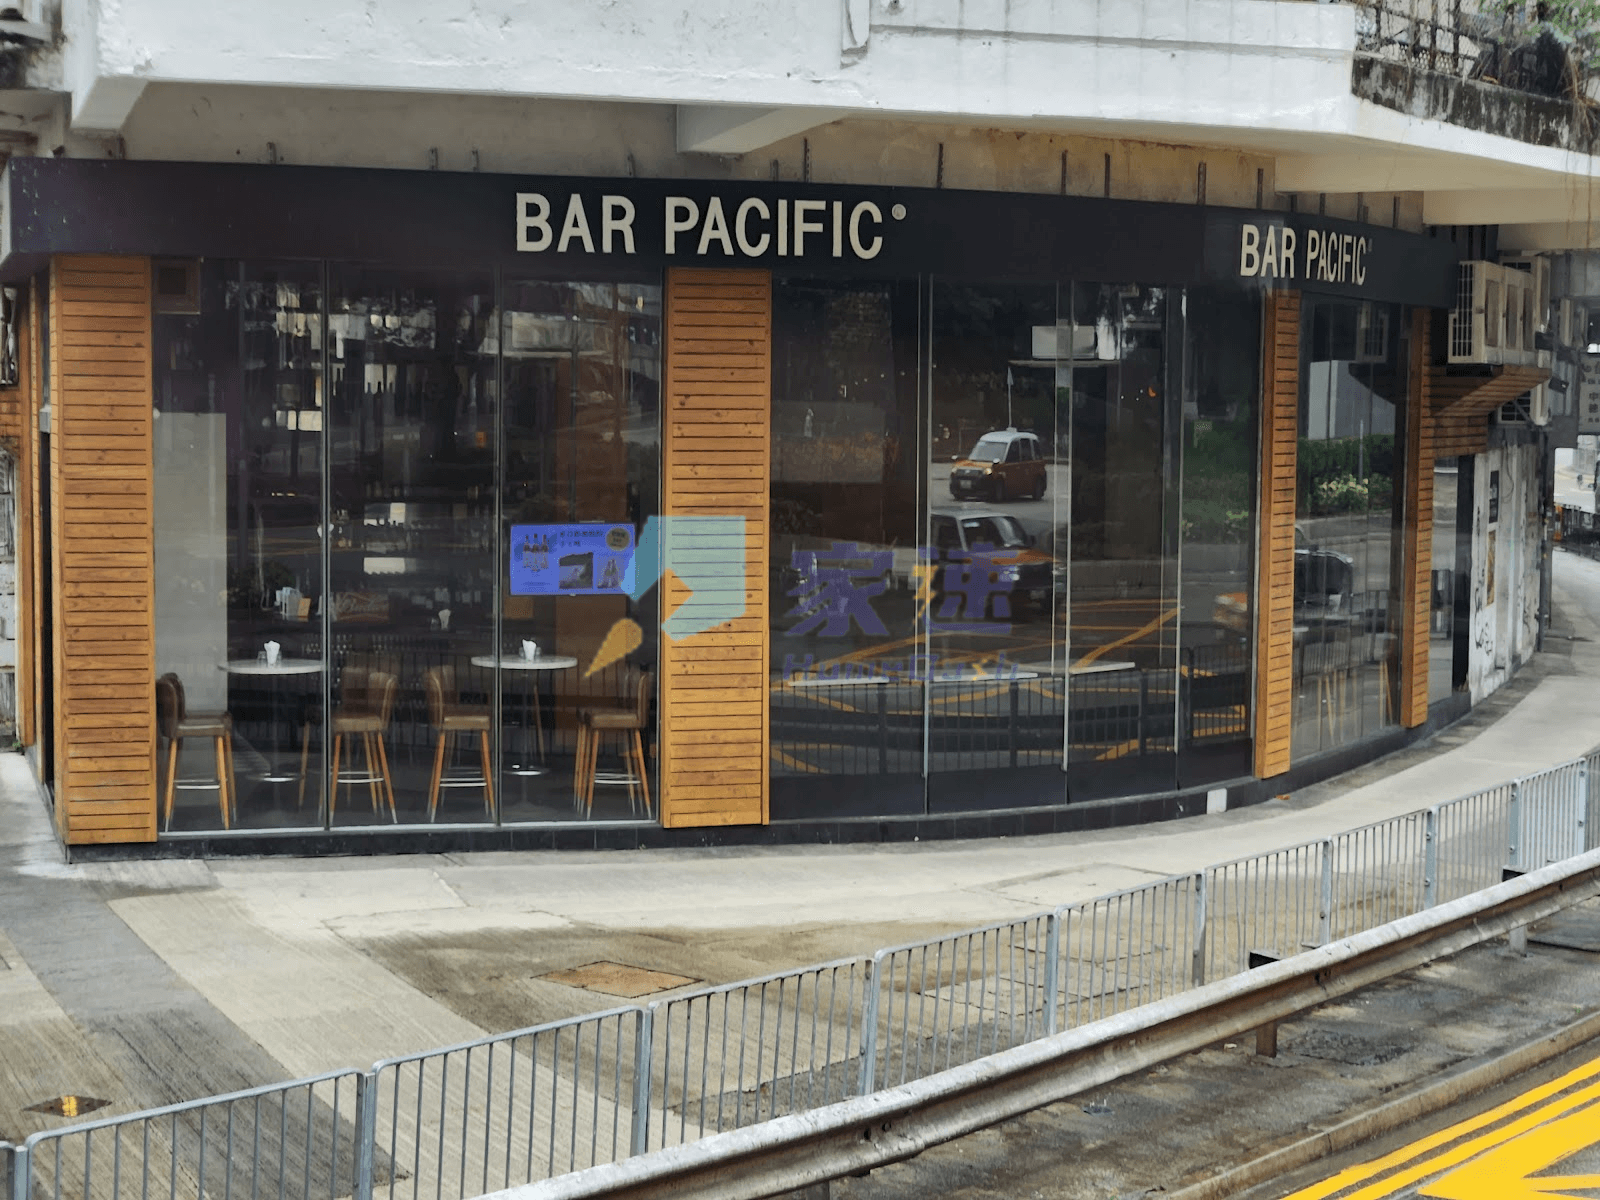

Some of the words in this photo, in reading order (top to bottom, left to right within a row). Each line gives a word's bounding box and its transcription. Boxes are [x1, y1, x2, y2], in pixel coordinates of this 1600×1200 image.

[516, 193, 636, 254] BAR
[665, 196, 884, 260] PACIFIC
[1240, 224, 1296, 279] BAR
[1306, 229, 1367, 286] PACIFIC
